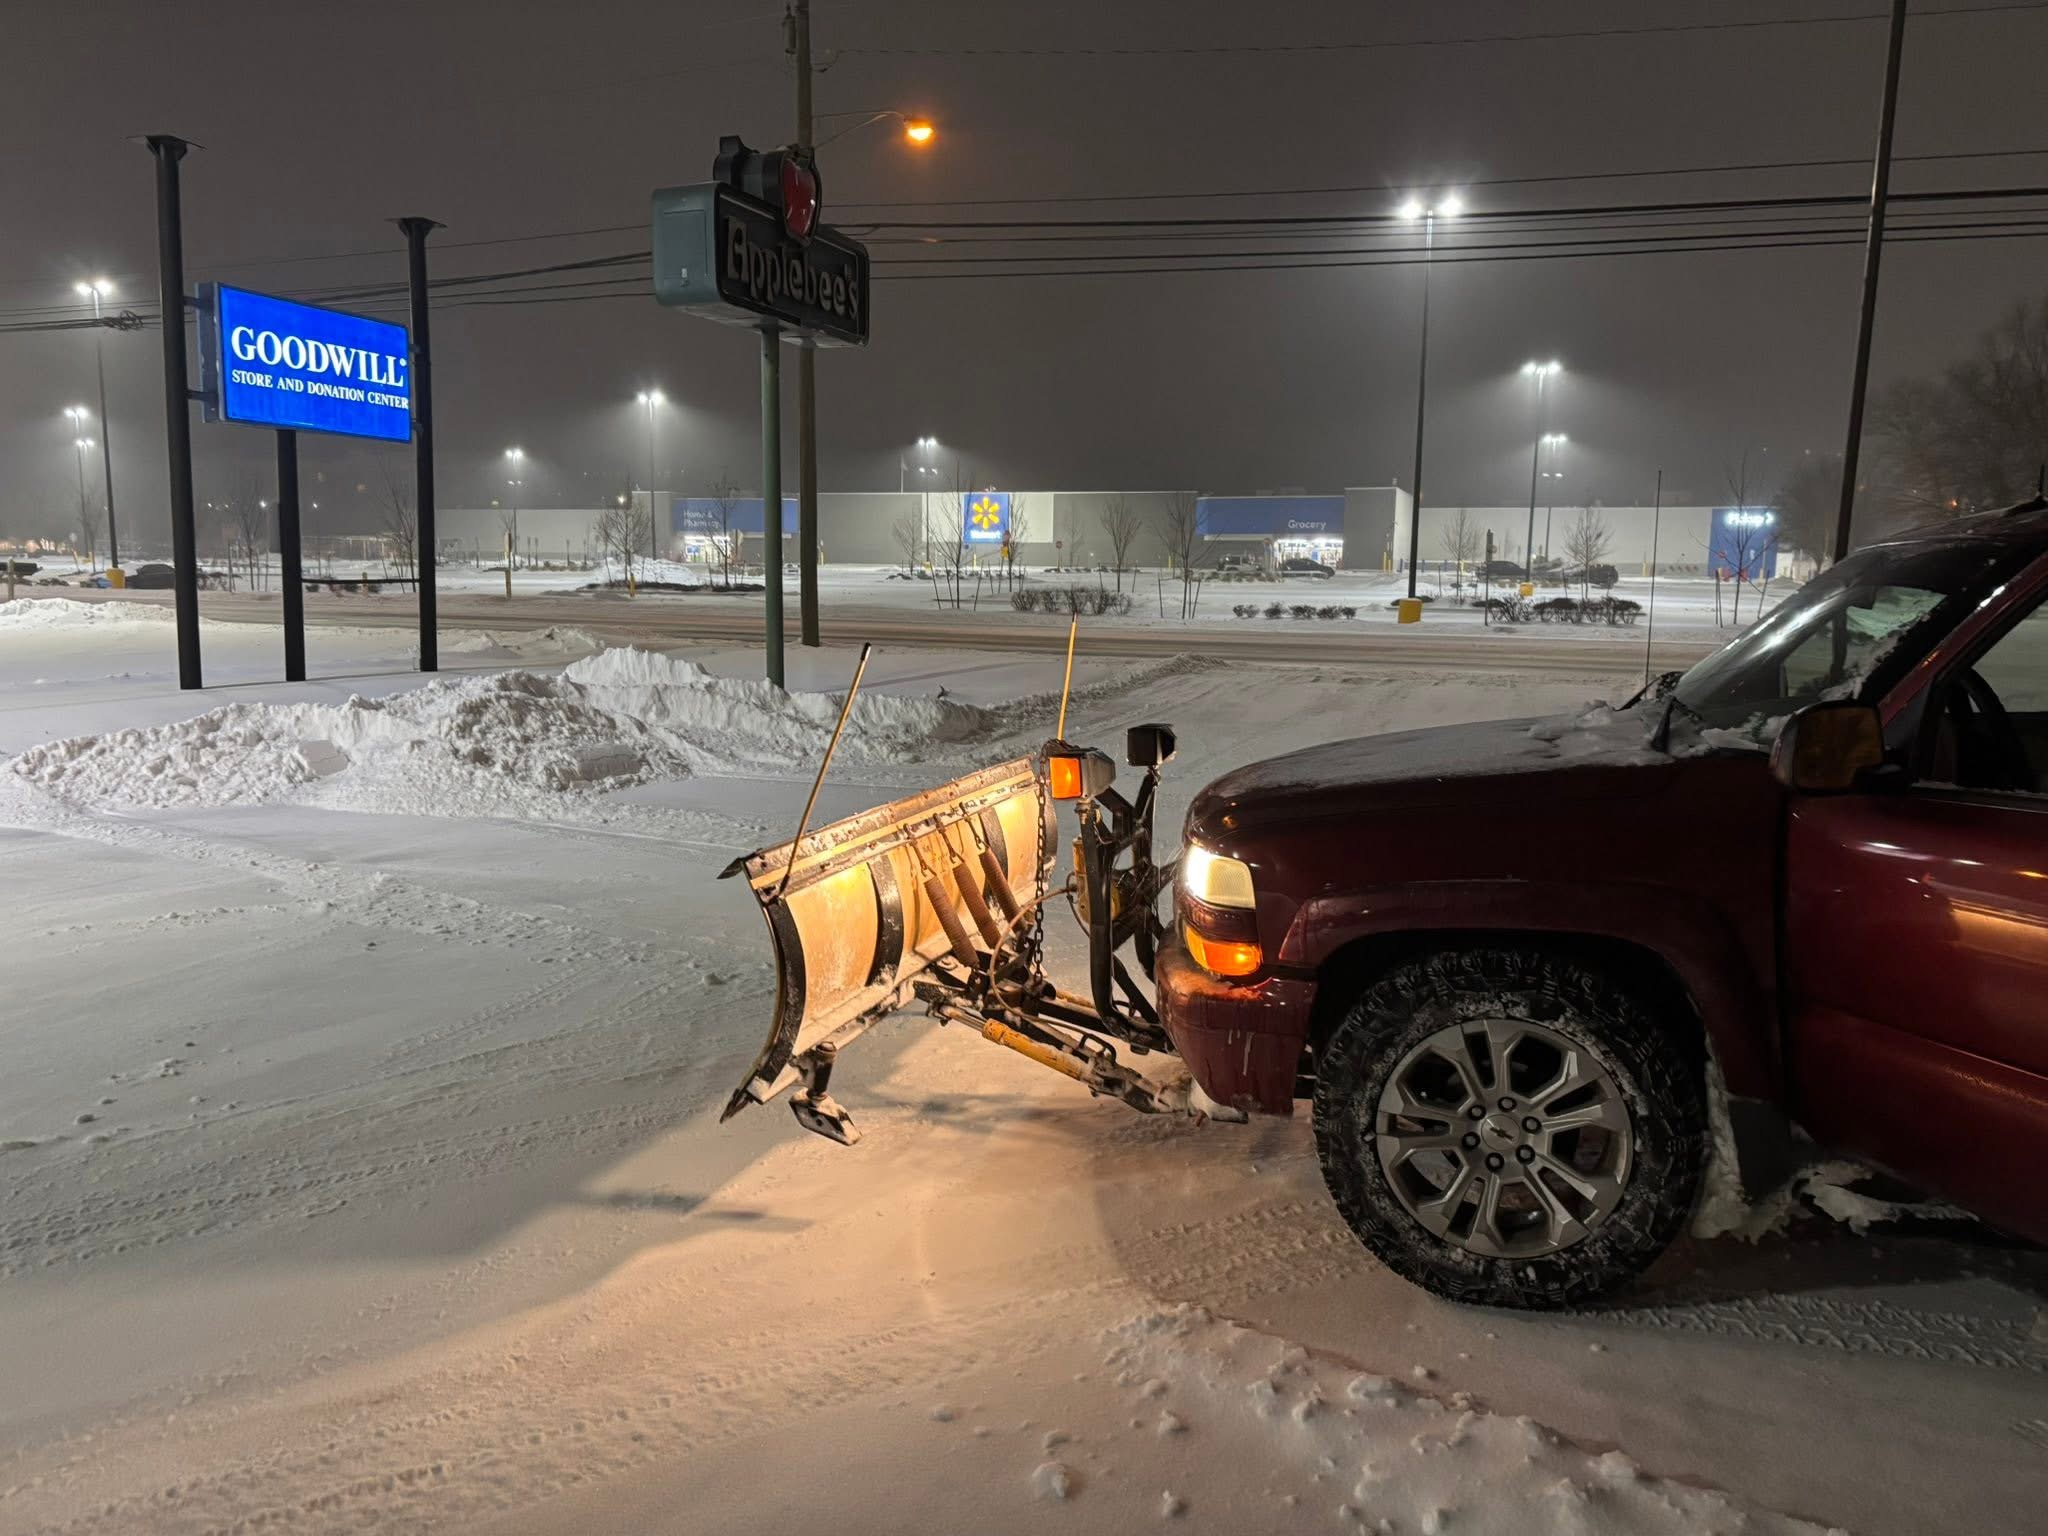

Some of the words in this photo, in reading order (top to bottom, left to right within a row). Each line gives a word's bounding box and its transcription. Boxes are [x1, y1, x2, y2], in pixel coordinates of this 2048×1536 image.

[727, 216, 858, 320] Applebee's
[231, 326, 404, 387] GOODWILL
[232, 369, 273, 387] STORE
[277, 377, 304, 393] AND
[307, 381, 365, 402] DONATION
[367, 391, 409, 409] CENTER
[1288, 519, 1327, 531] Grocery
